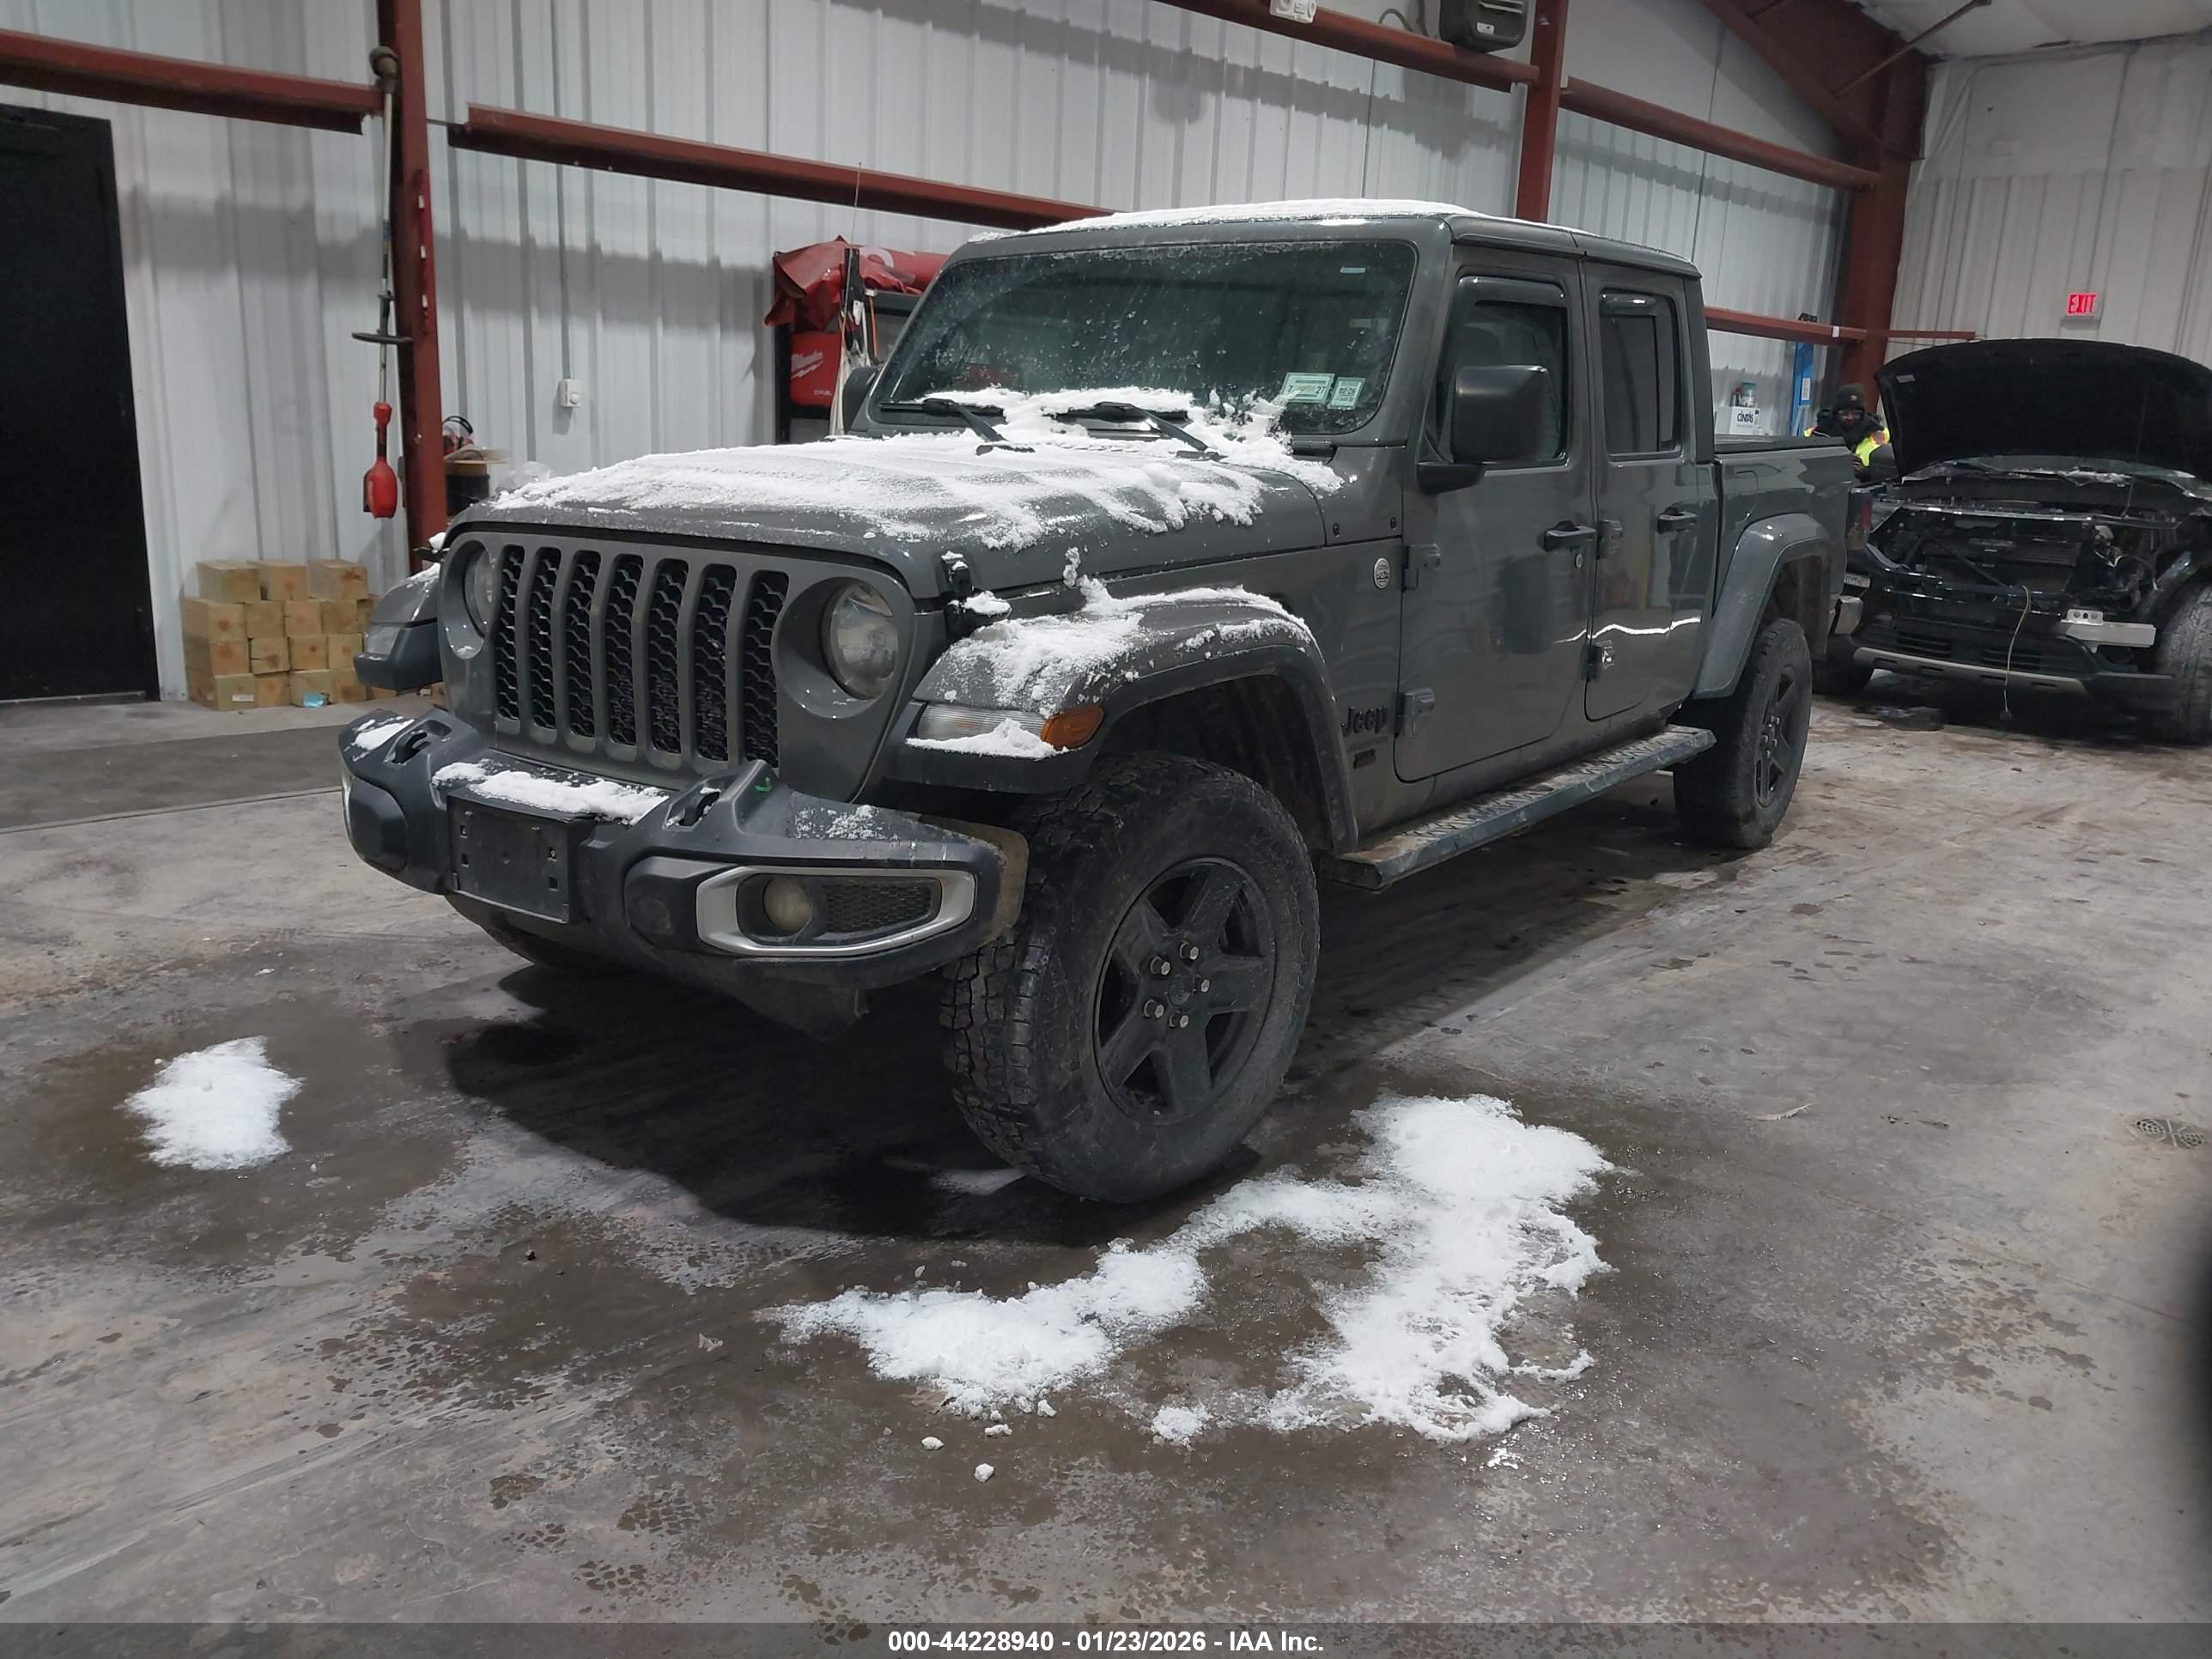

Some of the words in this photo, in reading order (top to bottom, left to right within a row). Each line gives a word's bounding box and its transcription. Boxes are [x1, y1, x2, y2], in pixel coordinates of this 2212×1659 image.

[2068, 294, 2096, 314] EXIT
[1316, 386, 1326, 394] 27
[1340, 706, 1388, 737] Jeep
